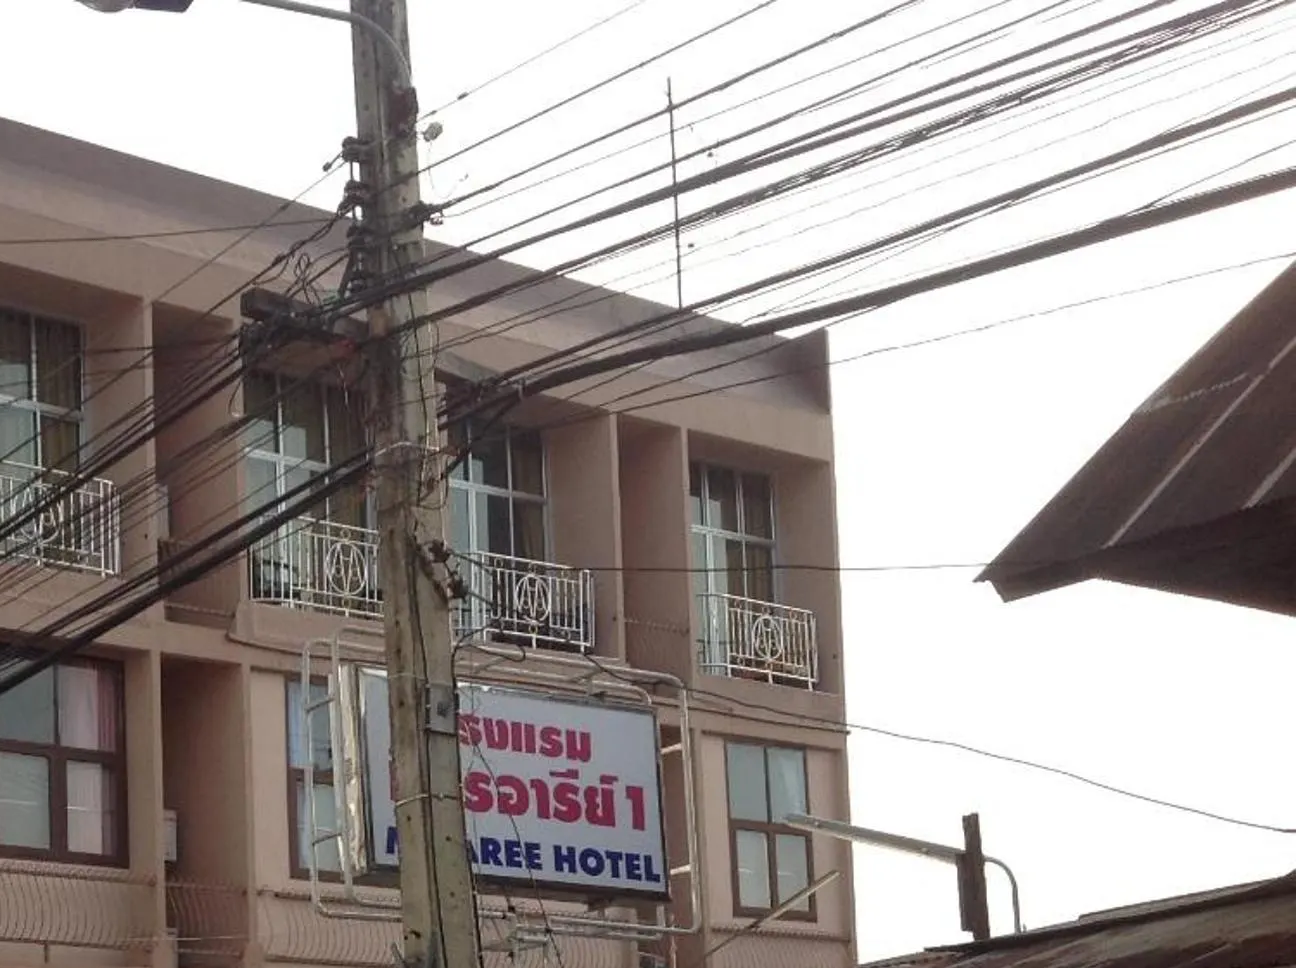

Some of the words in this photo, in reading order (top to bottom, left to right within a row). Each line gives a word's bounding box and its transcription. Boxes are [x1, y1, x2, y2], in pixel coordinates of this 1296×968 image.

[457, 712, 592, 763] รงแรม
[625, 786, 647, 832] 1
[554, 845, 662, 884] HOTEL
